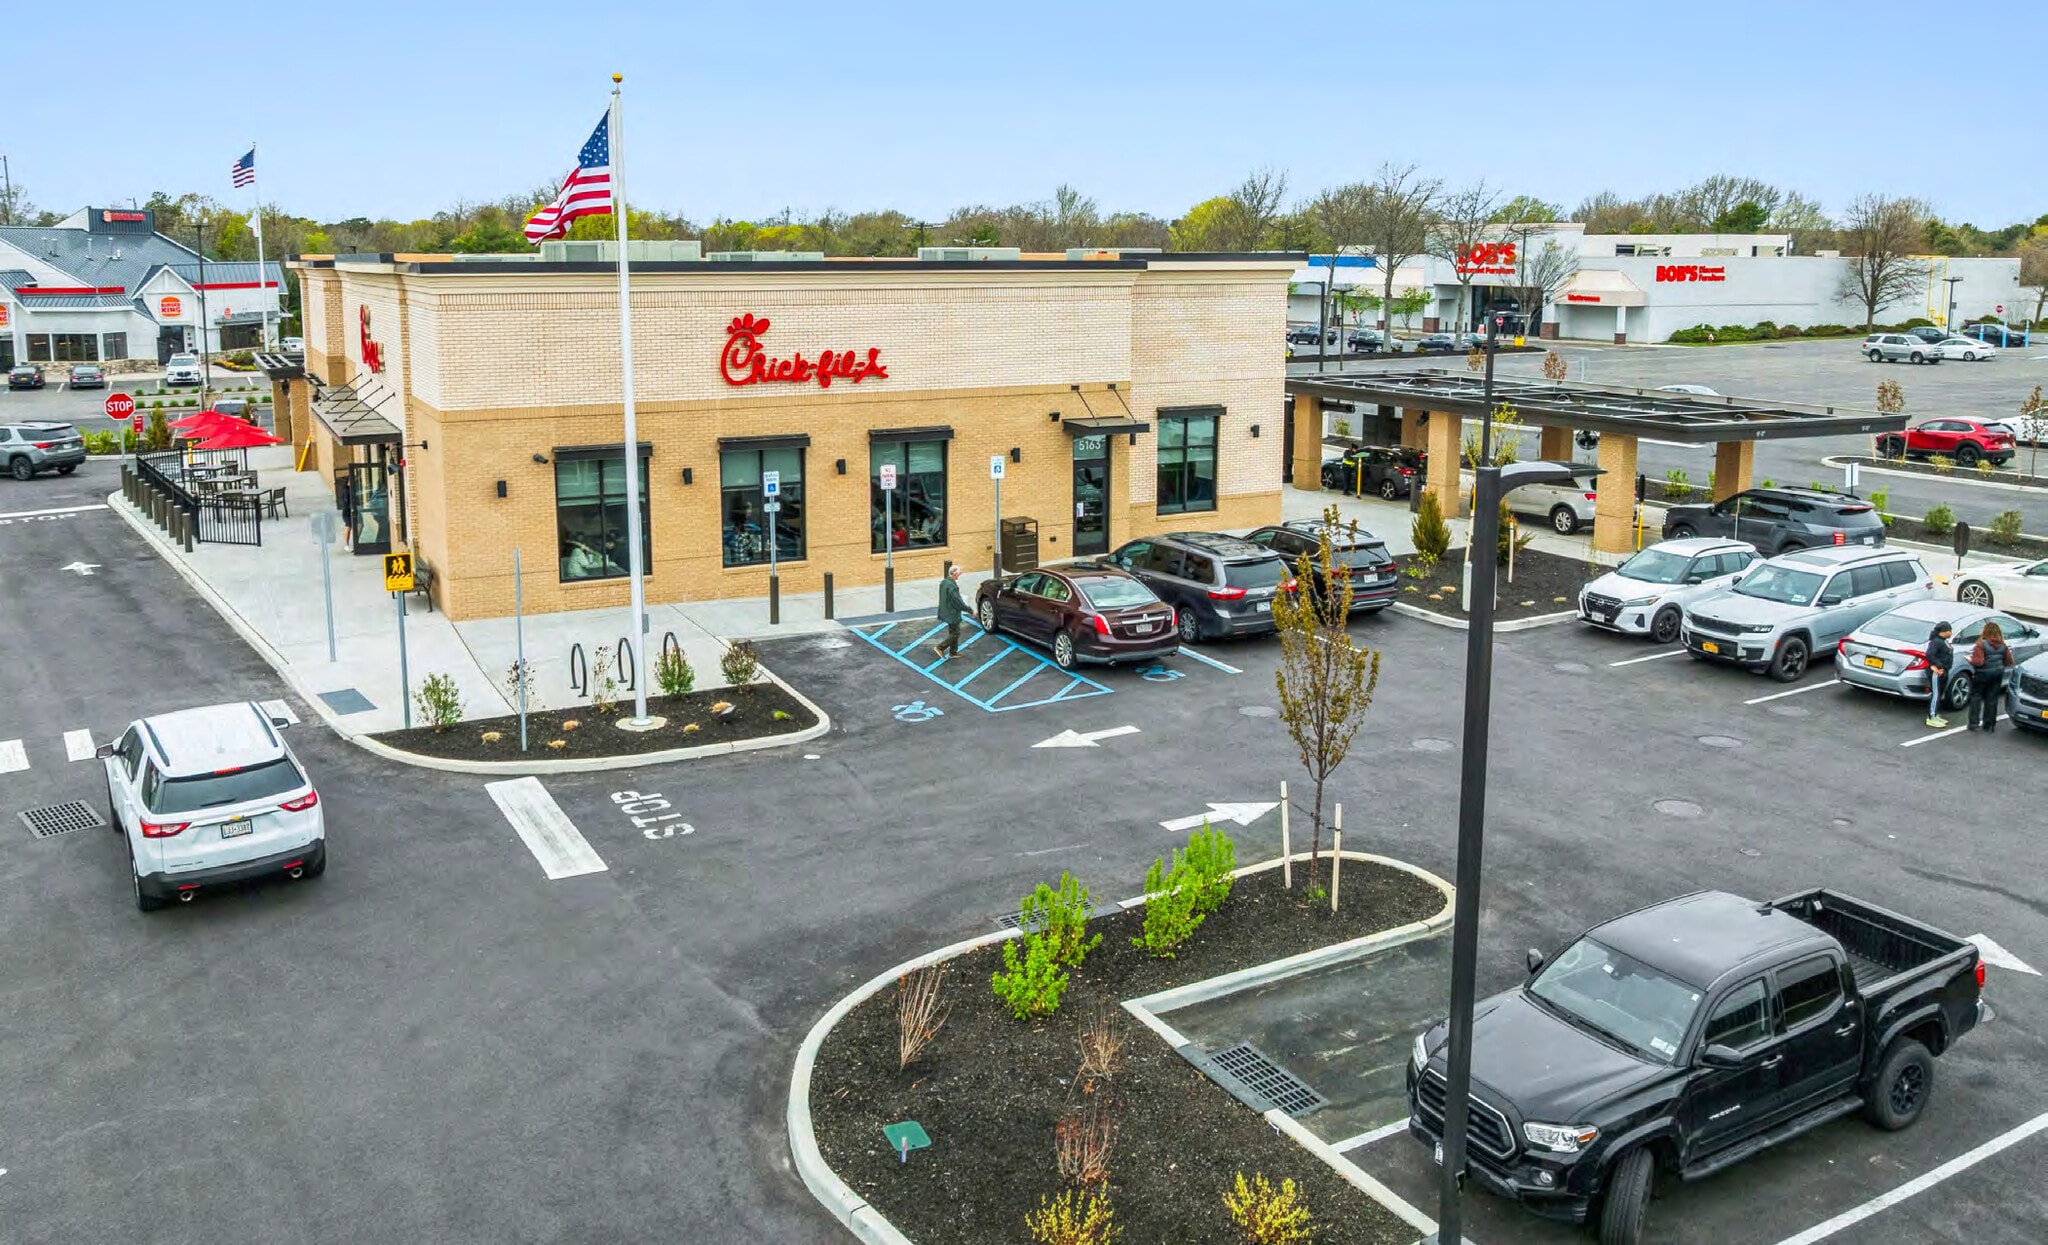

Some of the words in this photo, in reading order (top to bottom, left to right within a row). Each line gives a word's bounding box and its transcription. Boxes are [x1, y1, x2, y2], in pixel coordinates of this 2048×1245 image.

[1656, 266, 1698, 282] BOB'S
[720, 328, 889, 388] Chick-fil-A
[107, 401, 133, 412] STOP
[1079, 440, 1101, 451] 5163
[610, 790, 696, 840] STOP
